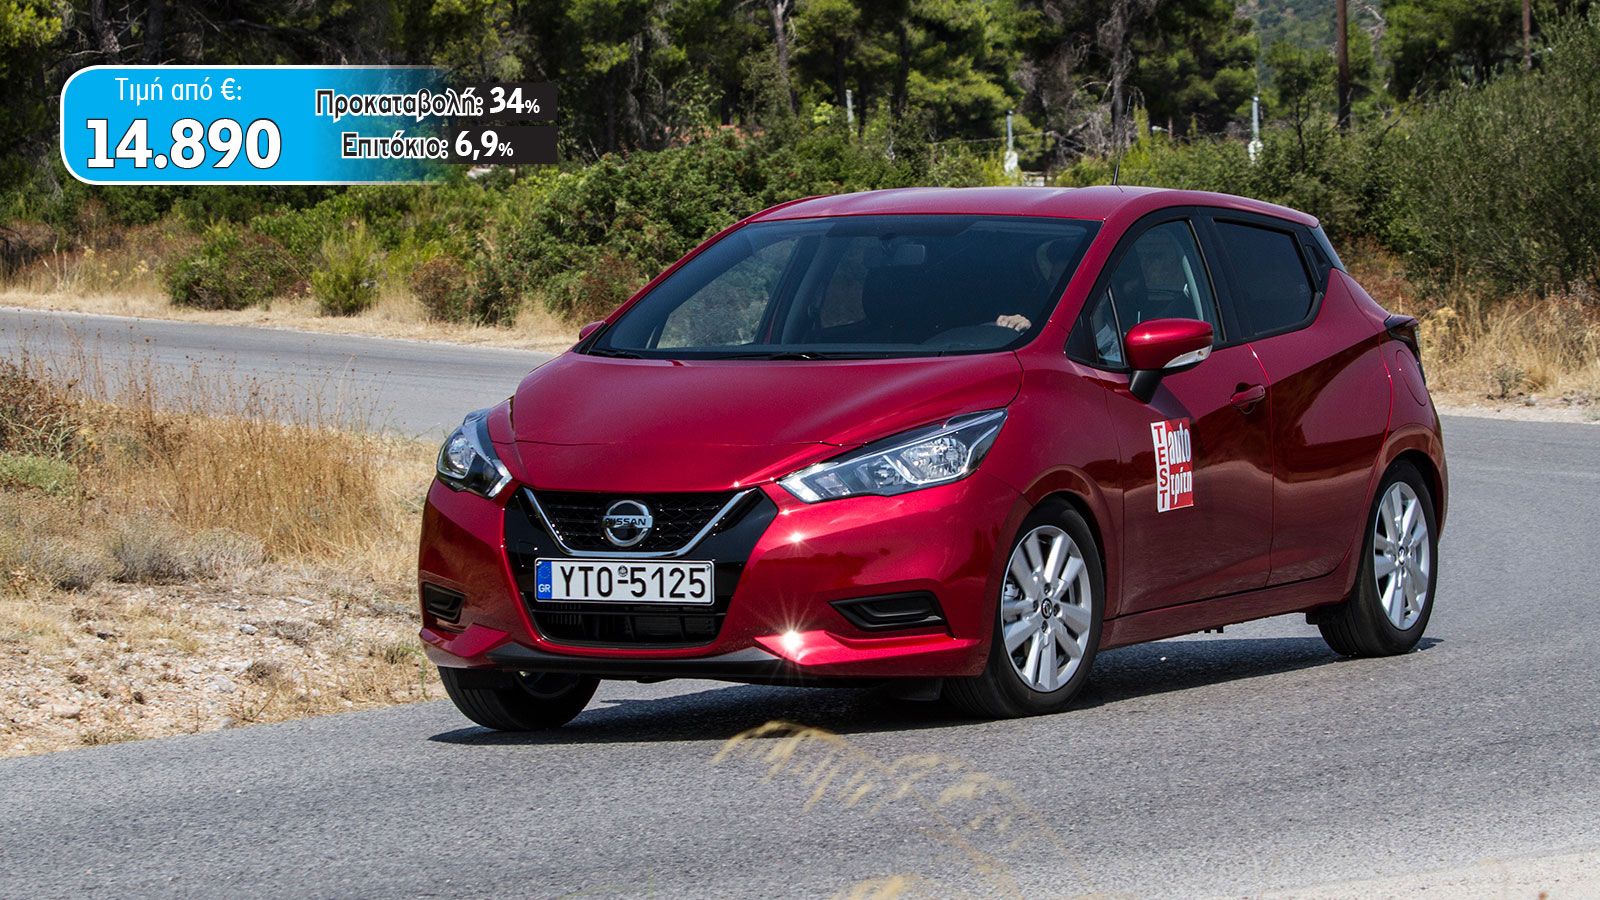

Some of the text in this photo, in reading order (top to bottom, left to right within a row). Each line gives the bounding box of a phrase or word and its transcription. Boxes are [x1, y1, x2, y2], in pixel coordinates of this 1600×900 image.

[1168, 422, 1191, 465] auto
[1154, 425, 1168, 509] TEST
[538, 583, 551, 593] GR
